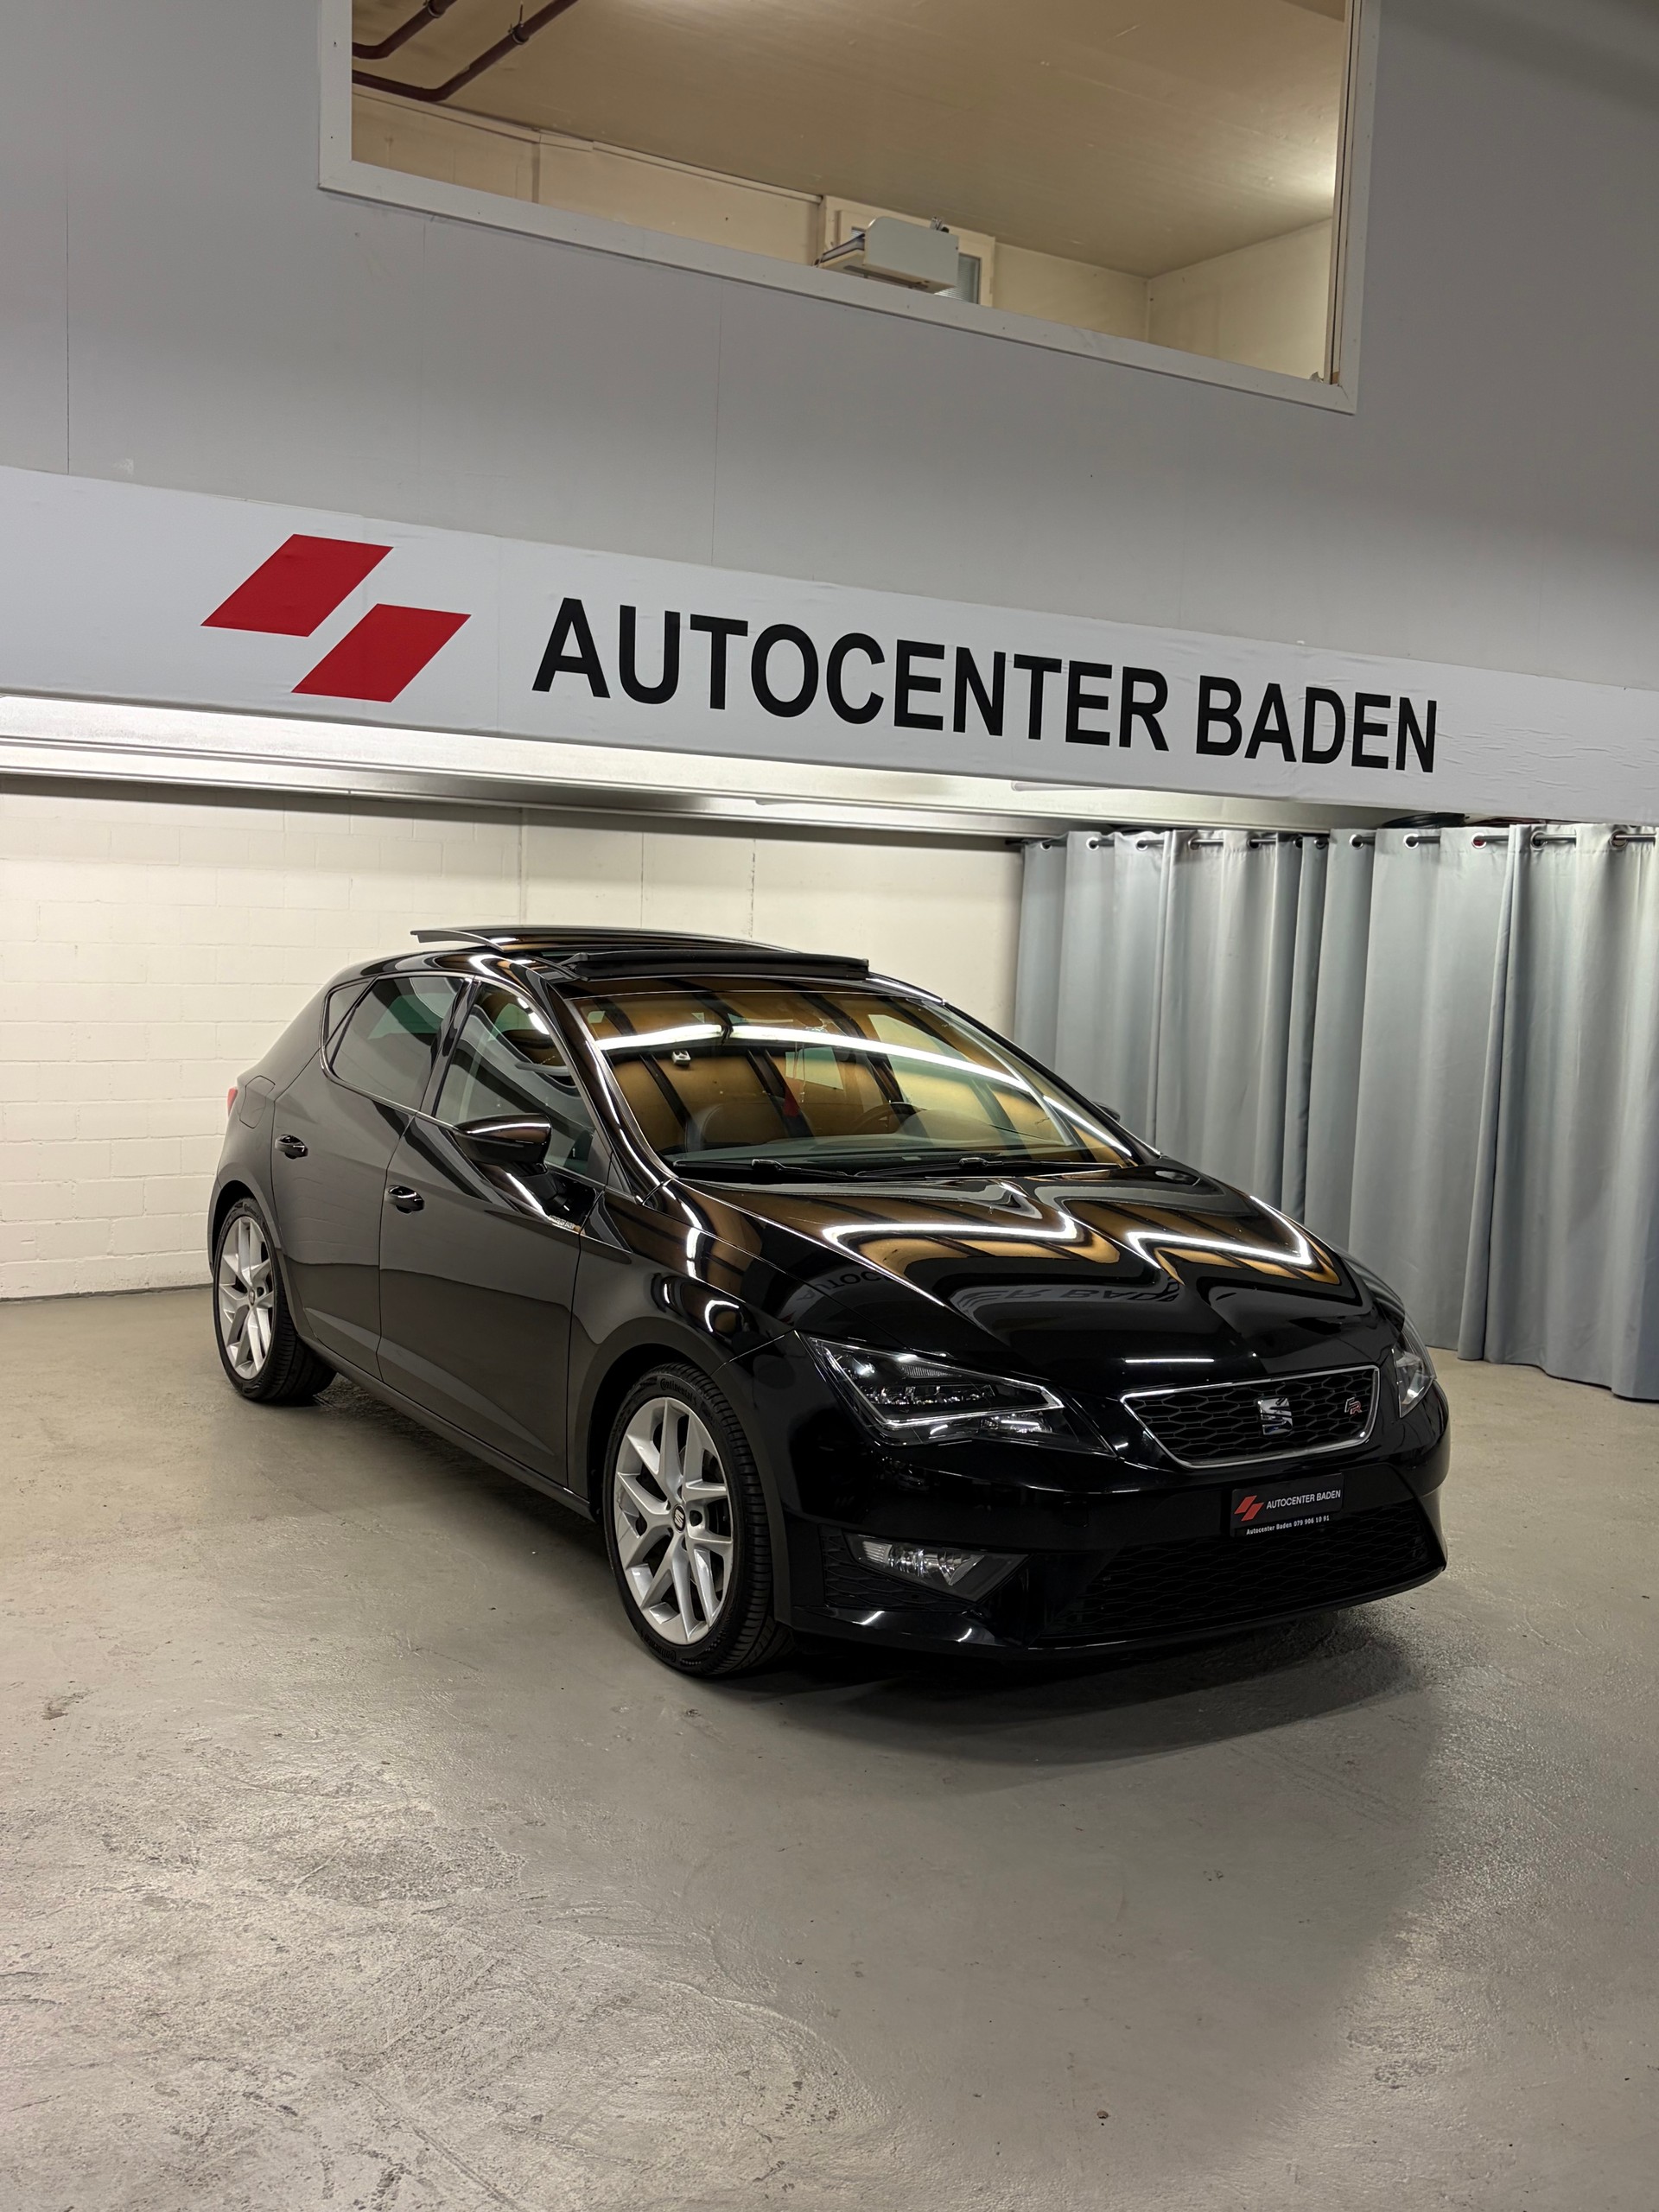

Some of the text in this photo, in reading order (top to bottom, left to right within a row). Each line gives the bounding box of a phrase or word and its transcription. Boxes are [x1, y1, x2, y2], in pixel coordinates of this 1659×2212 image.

[533, 596, 1436, 773] AUTOCENTER BADEN
[1346, 1397, 1363, 1415] FR
[1266, 1490, 1341, 1510] AUTOCENTER BADEN
[1246, 1526, 1274, 1535] Autocenter
[1276, 1522, 1293, 1530] Baden
